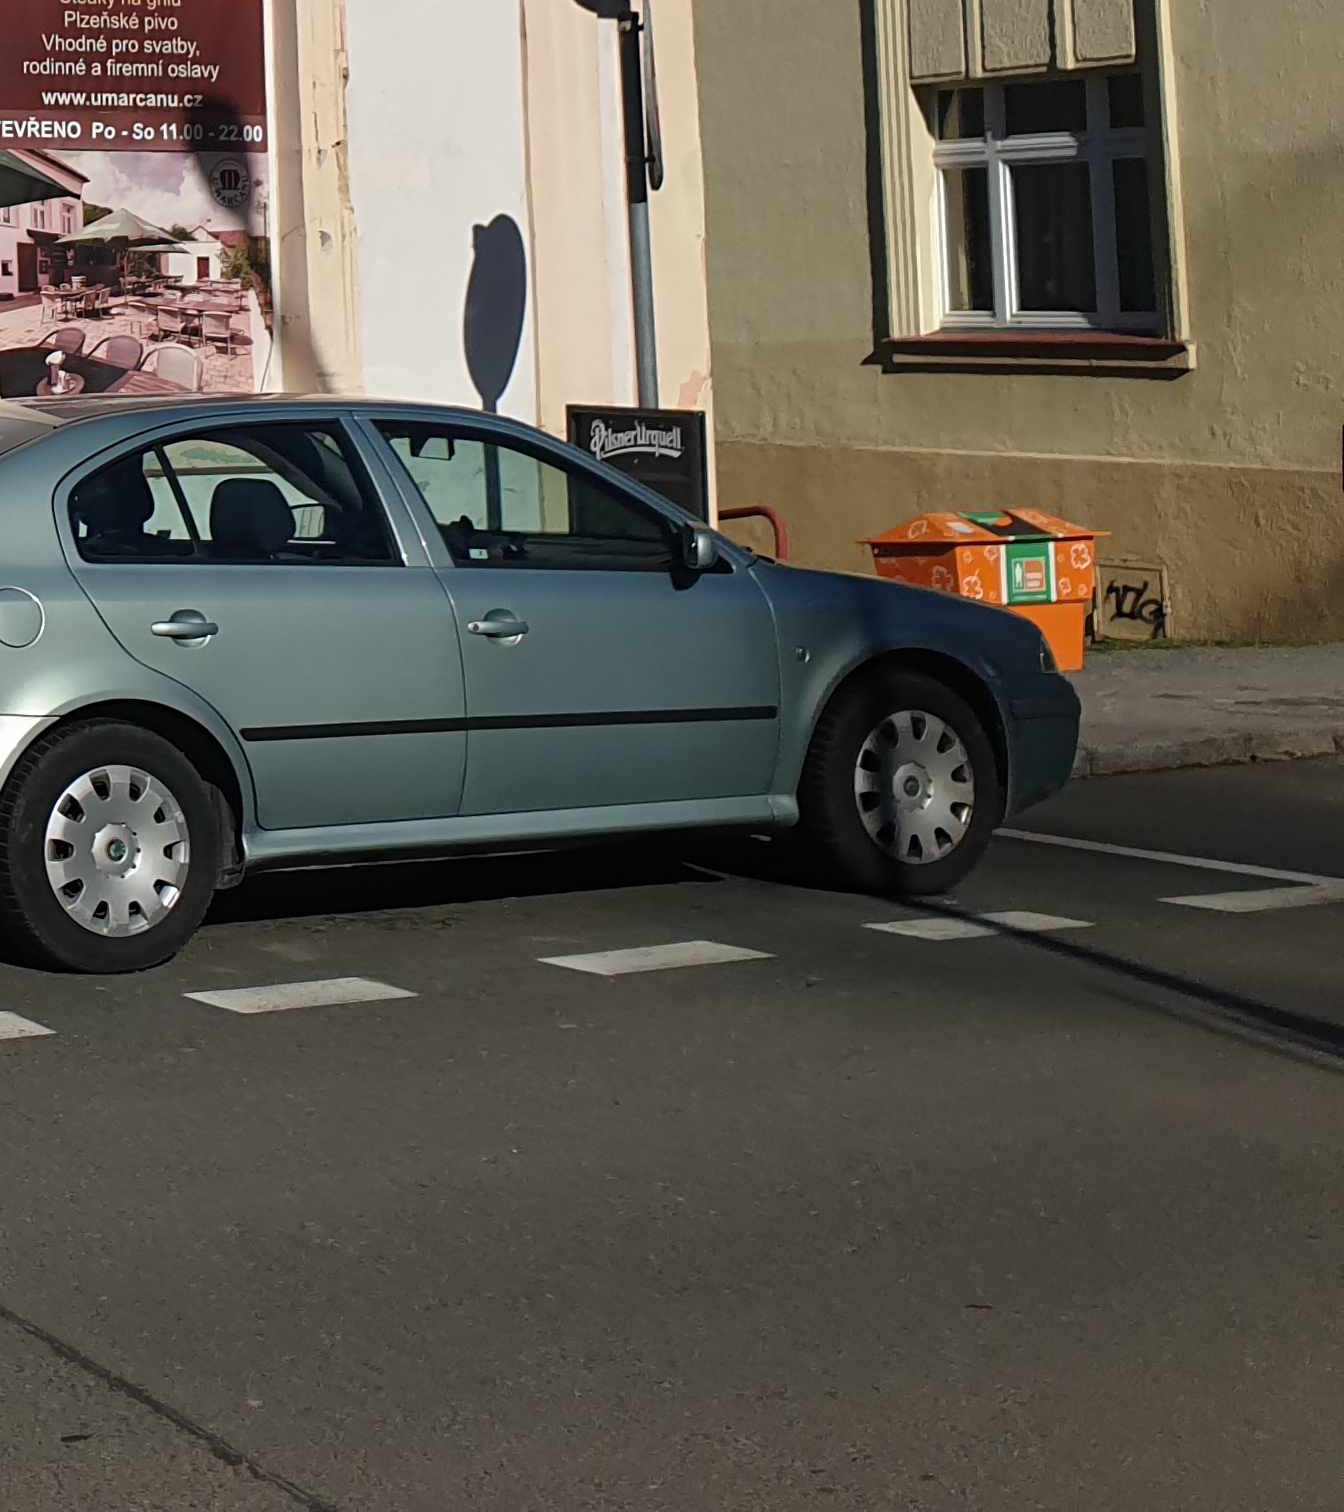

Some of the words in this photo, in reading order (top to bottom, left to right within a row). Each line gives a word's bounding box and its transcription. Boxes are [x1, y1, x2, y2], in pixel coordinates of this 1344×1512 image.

[64, 10, 139, 29] Plzeňské
[144, 13, 178, 33] pivo
[42, 34, 107, 52] Vhodné
[112, 39, 139, 56] pro
[143, 36, 200, 57] svatby,
[23, 58, 86, 76] rodinné
[91, 62, 102, 76] a
[106, 59, 163, 77] firemní
[168, 61, 220, 82] oslavy
[42, 91, 204, 108] www.umarcanu.cz
[91, 122, 116, 139] Po
[132, 122, 155, 140] So
[160, 122, 203, 141] 11.00
[218, 124, 263, 142] 22.00
[590, 418, 637, 460] Pilsner
[634, 419, 682, 457] Urquell
